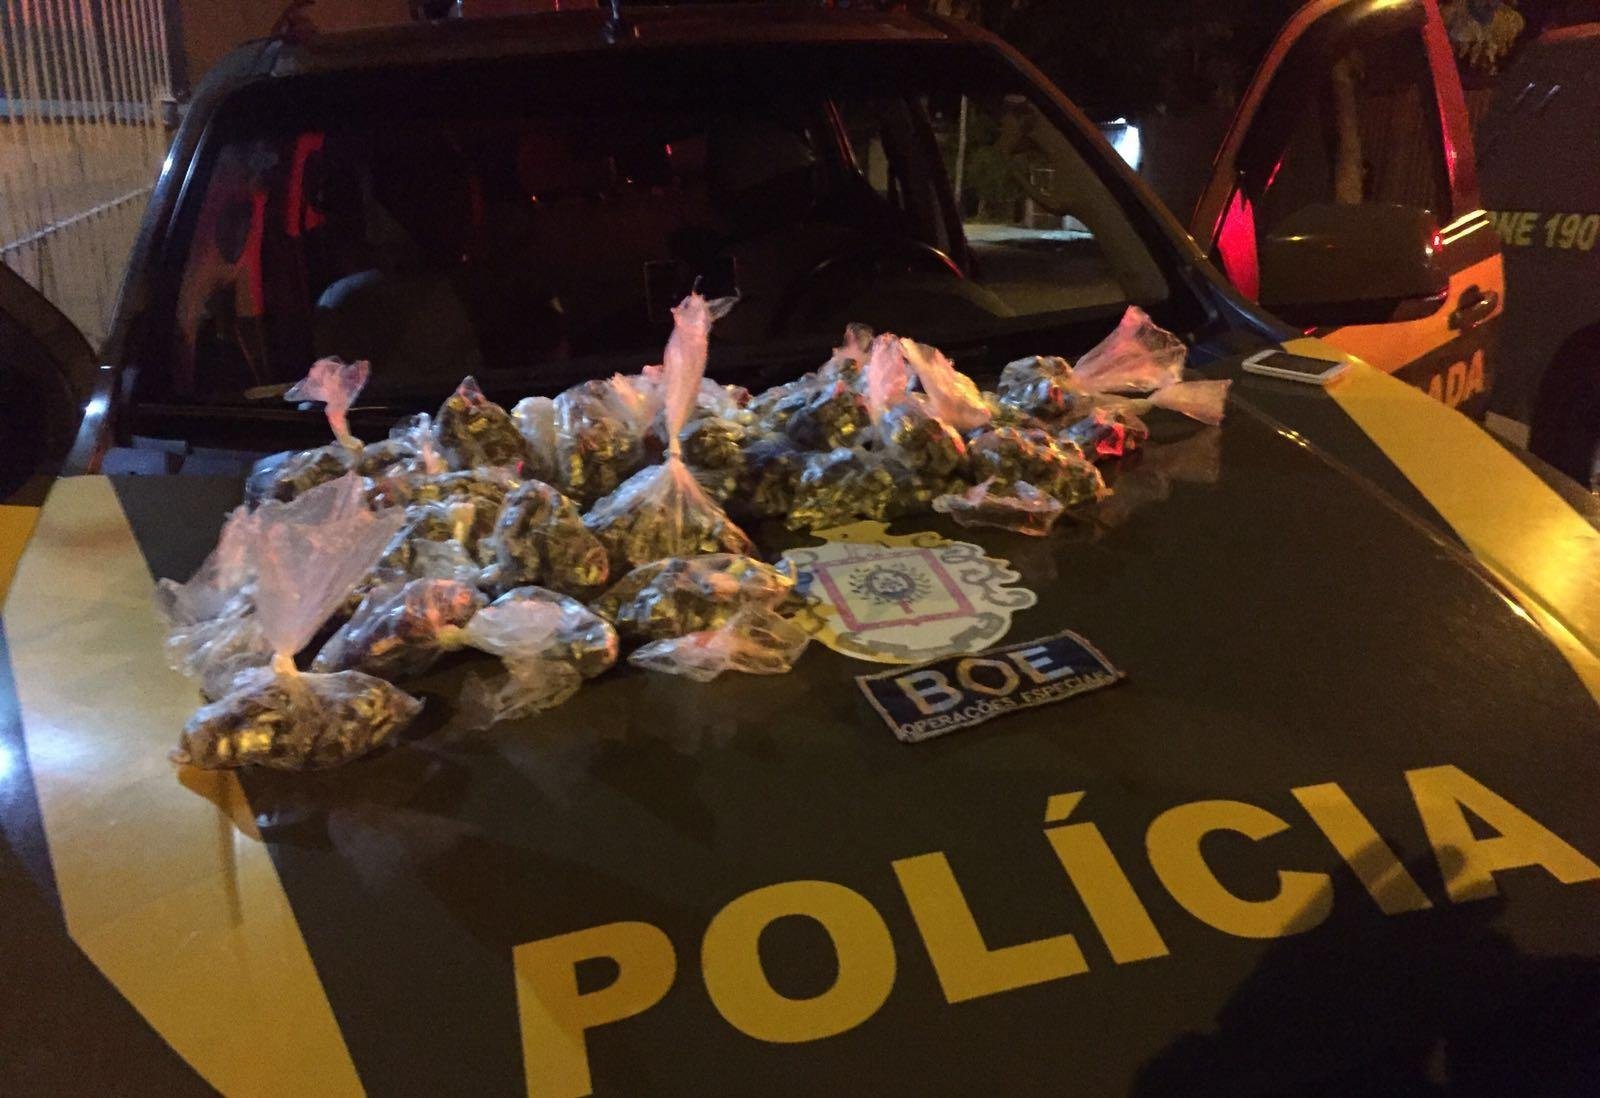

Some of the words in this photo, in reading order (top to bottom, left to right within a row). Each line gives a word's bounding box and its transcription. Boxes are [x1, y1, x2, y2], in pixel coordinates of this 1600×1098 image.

[1544, 213, 1600, 251] 190
[894, 646, 1075, 716] BOE
[512, 765, 1600, 1098] POLÍCIA
